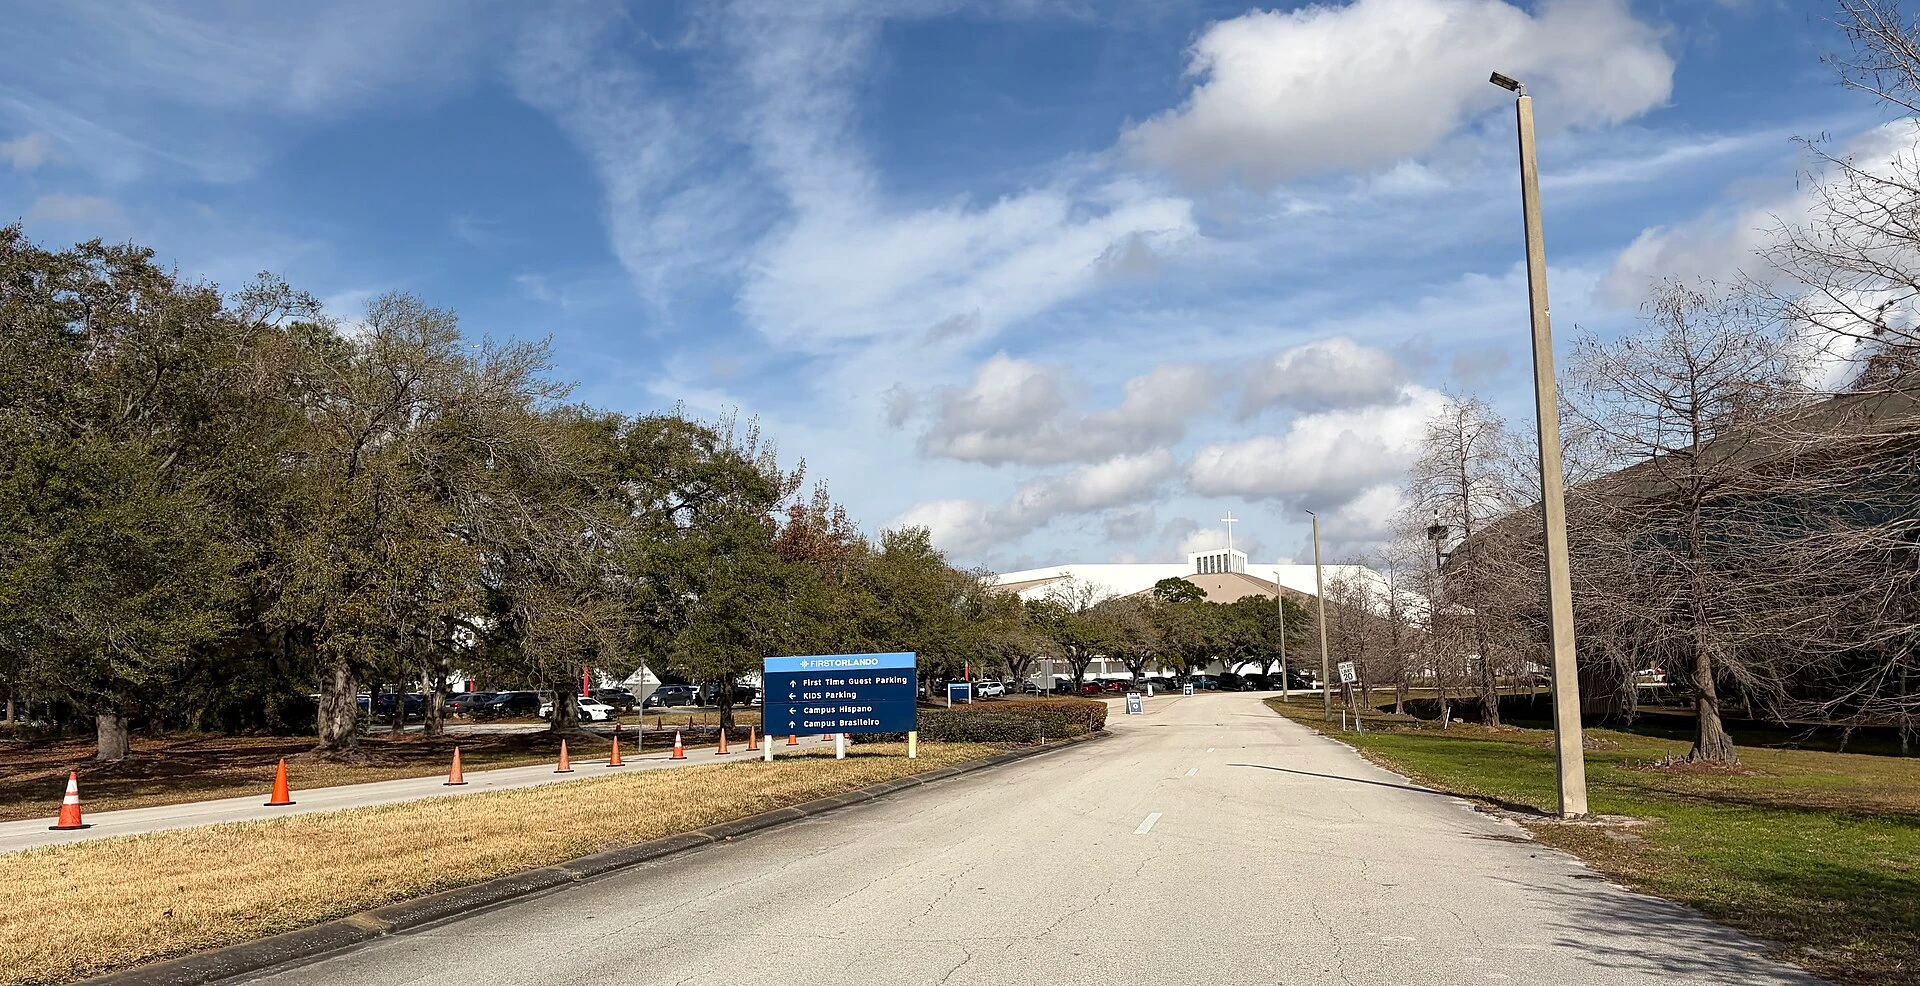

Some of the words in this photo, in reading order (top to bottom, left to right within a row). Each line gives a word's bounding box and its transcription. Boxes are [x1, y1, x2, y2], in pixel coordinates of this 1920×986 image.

[810, 658, 879, 667] FIRSTORLANDO
[825, 678, 845, 686] Time
[848, 677, 872, 685] Guest
[875, 676, 907, 685] Parking
[1343, 673, 1353, 681] 20
[803, 692, 822, 700] KIDS
[825, 691, 857, 700] Parking
[803, 706, 836, 715] Campus
[839, 705, 872, 714] Hispano
[803, 720, 836, 729] Campus
[839, 718, 880, 727] Brasileiro
